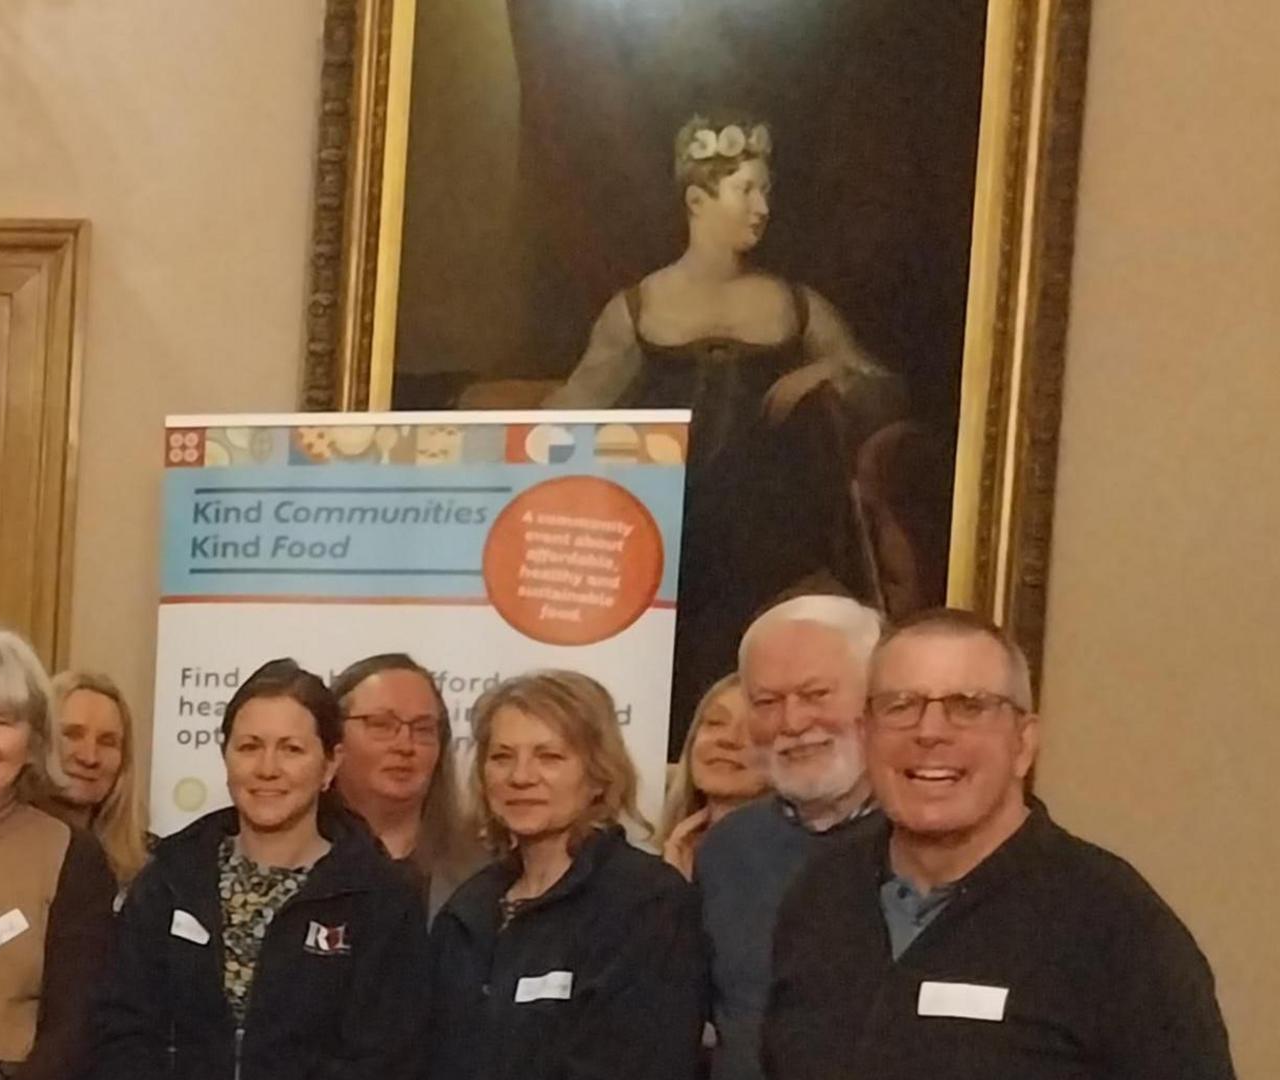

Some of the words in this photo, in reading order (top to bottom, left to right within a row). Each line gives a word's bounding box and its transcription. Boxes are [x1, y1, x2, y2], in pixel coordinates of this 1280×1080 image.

[191, 500, 263, 526] Kind
[272, 499, 489, 527] Communities
[520, 510, 534, 524] A
[536, 513, 635, 539] community
[189, 534, 262, 560] Kind
[268, 534, 352, 561] Food
[573, 533, 625, 552] about
[586, 575, 621, 590] and
[181, 667, 240, 689] Find
